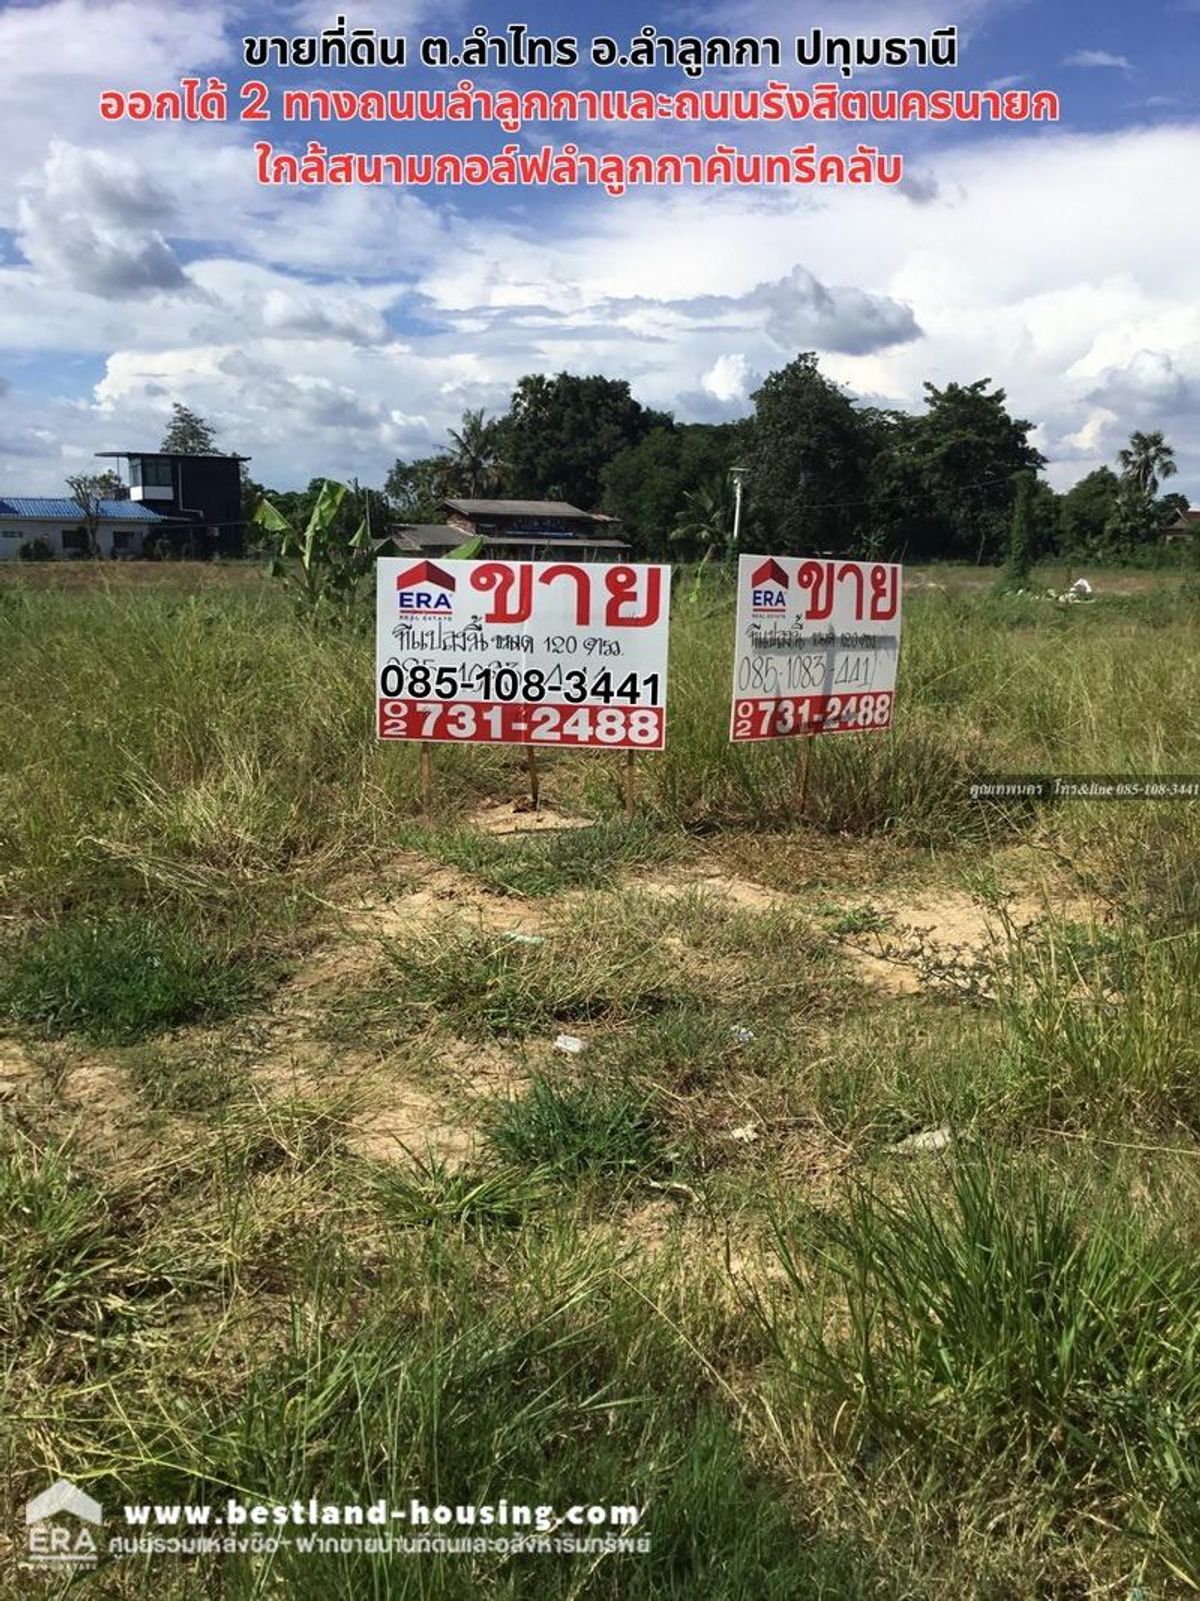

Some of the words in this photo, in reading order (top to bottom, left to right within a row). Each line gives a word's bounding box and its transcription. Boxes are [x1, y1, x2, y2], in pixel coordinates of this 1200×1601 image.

[399, 592, 452, 609] ERA
[470, 563, 661, 628] ขาย
[752, 590, 786, 607] ERA
[797, 561, 898, 621] ขาย
[544, 636, 577, 654] 120
[416, 703, 660, 744] 731-2488
[758, 694, 890, 736] 731-2488
